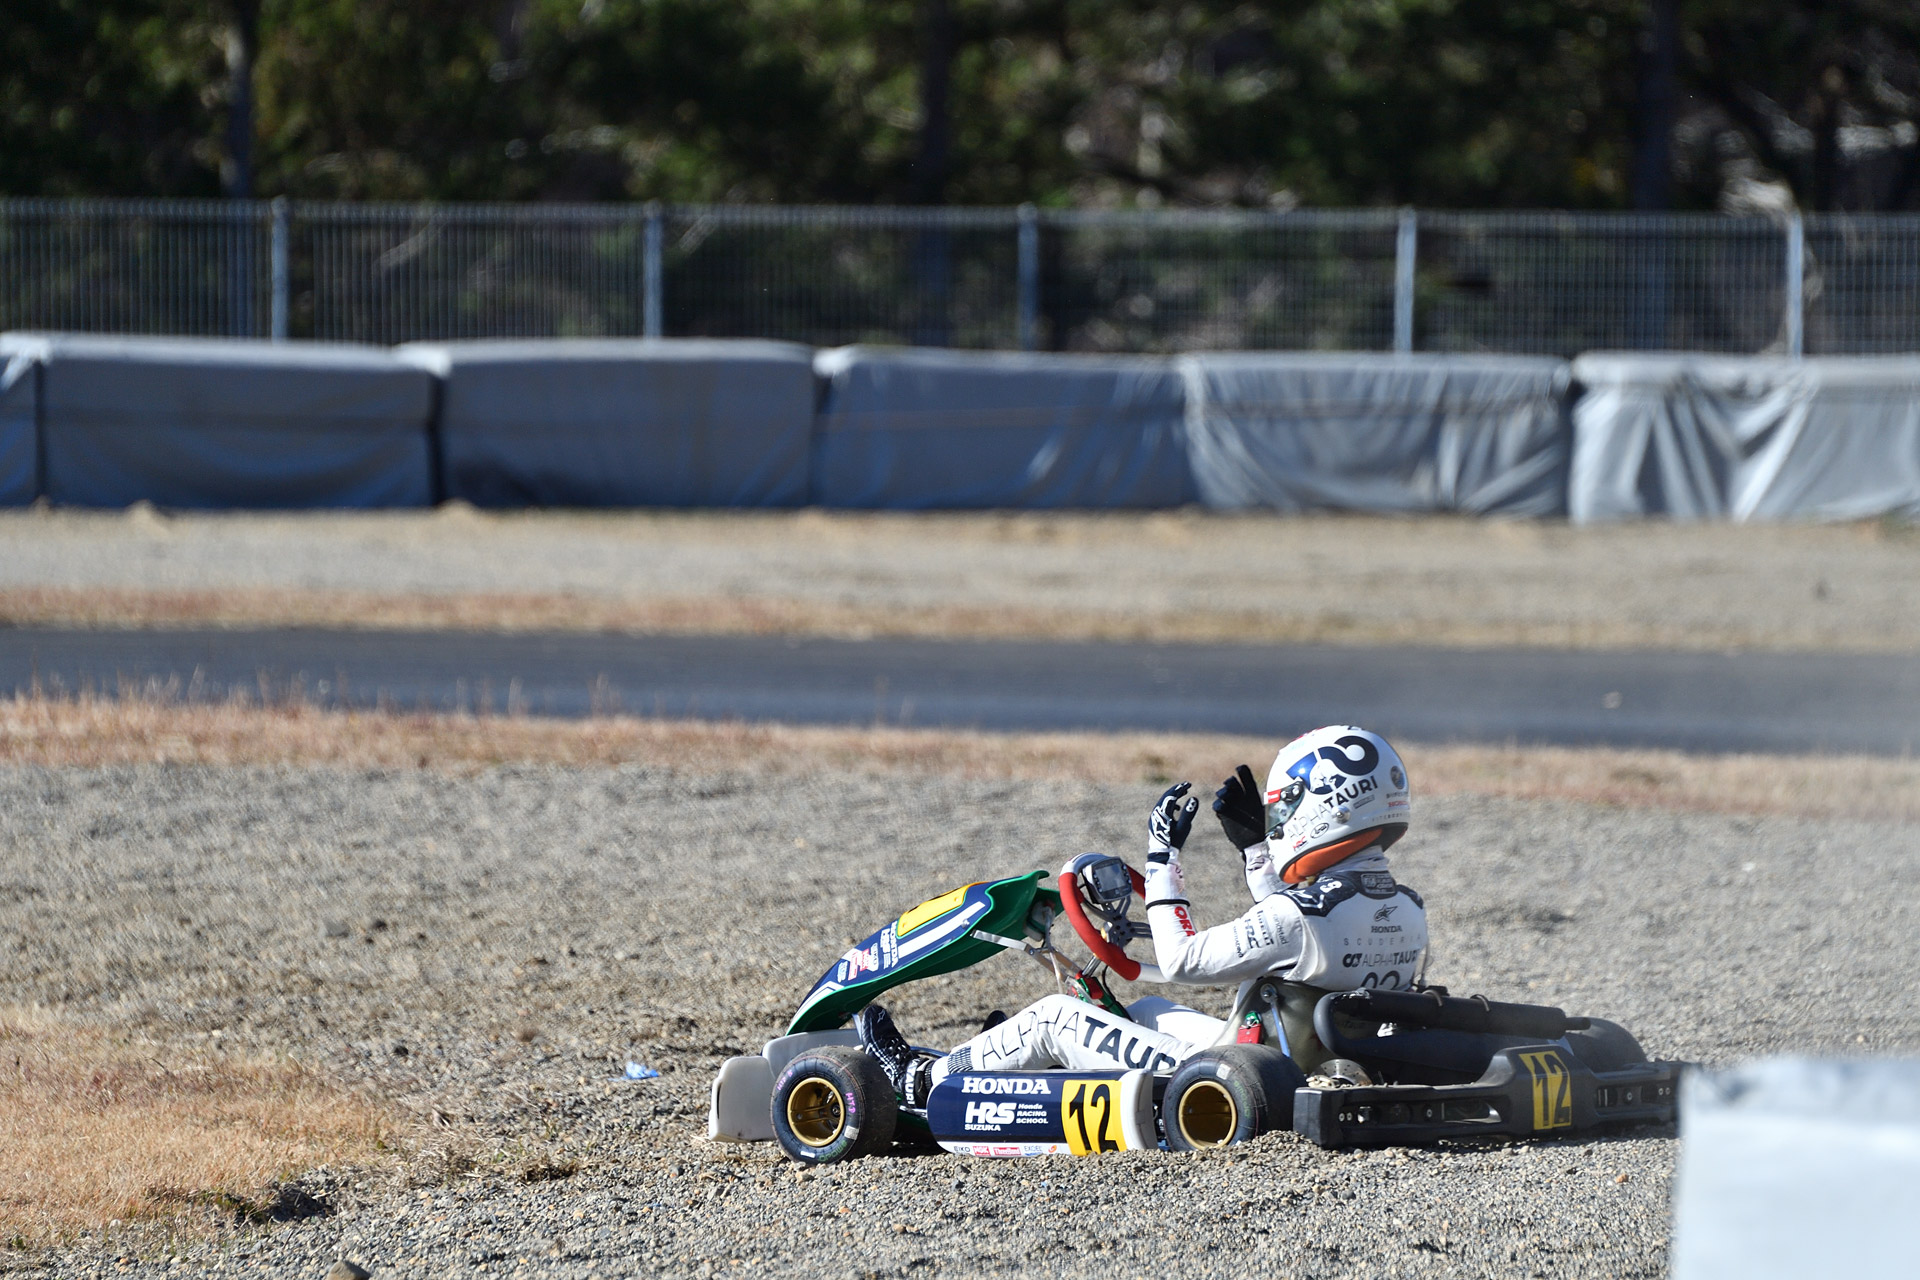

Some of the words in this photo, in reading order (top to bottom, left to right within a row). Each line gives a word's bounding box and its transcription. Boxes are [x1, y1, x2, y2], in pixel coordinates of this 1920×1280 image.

[1371, 925, 1402, 933] HONDA
[961, 1077, 1052, 1094] HONDA
[1529, 1053, 1571, 1127] 12
[965, 1101, 1017, 1124] HRS
[1069, 1084, 1120, 1151] 12
